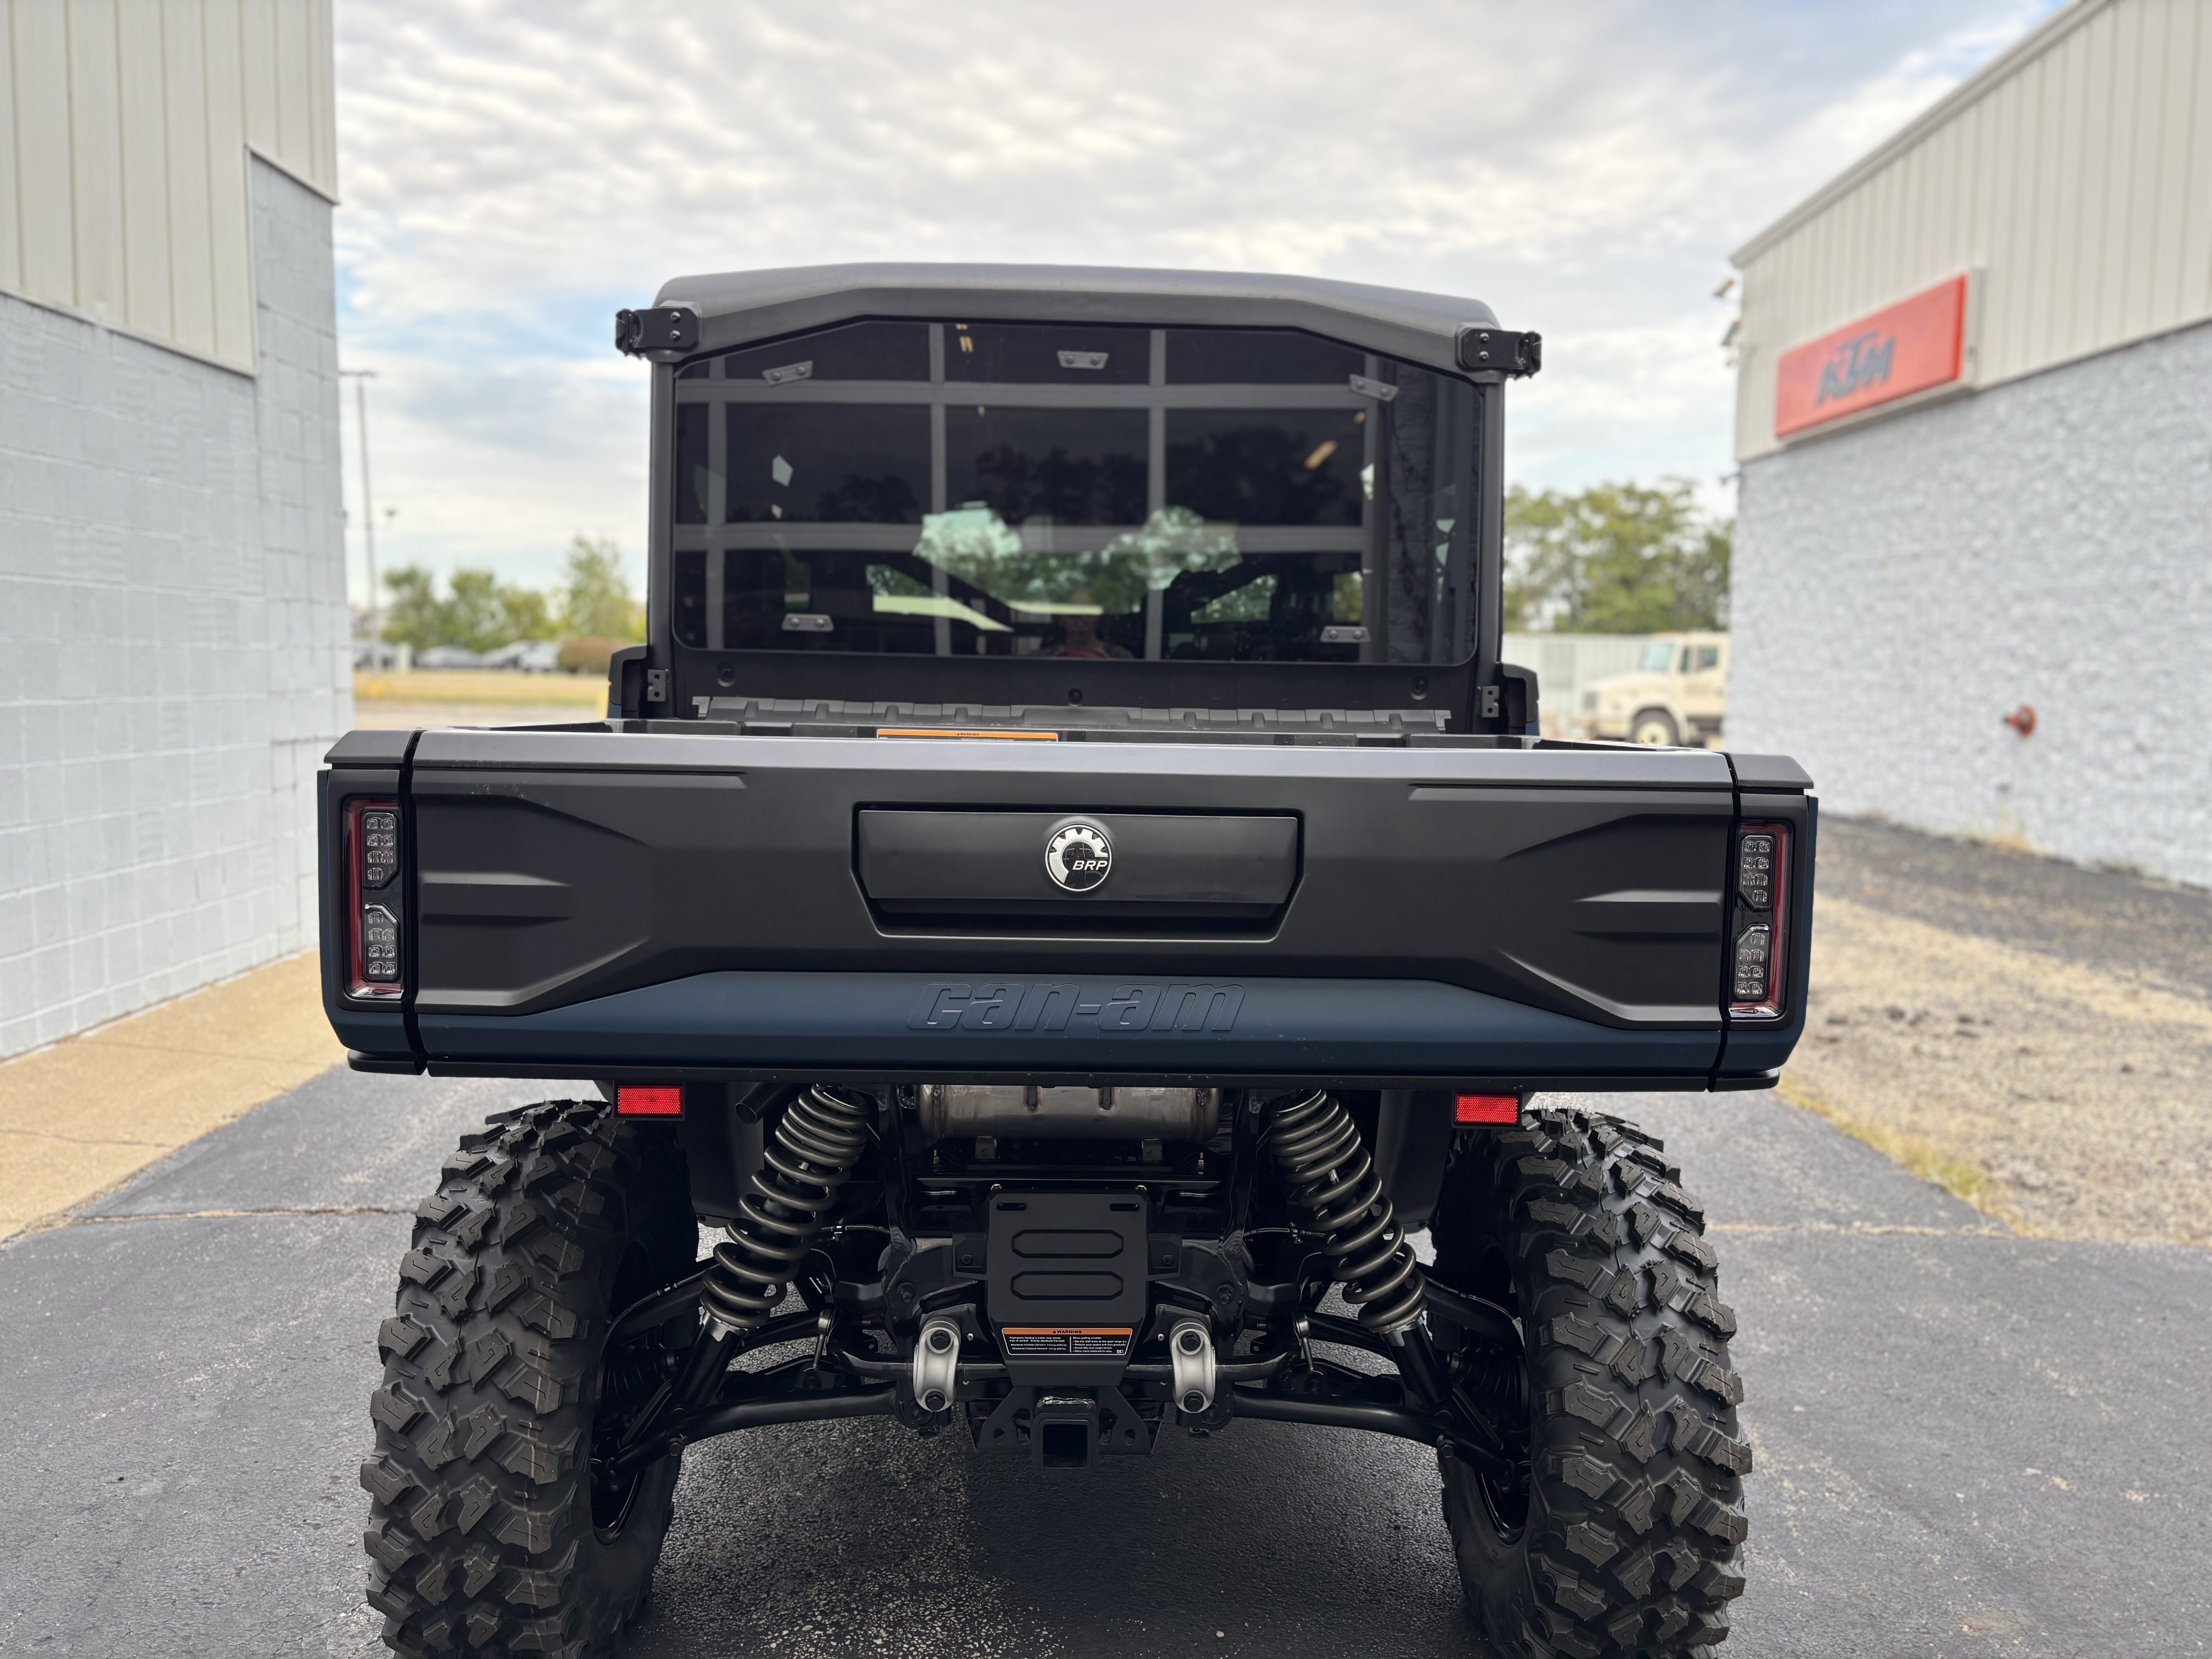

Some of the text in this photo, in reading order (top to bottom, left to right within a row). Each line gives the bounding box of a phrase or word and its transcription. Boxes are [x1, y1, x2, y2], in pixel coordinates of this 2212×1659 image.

[1815, 328, 1896, 405] KTM
[1072, 860, 1108, 871] BRP
[907, 982, 1246, 1031] can-am
